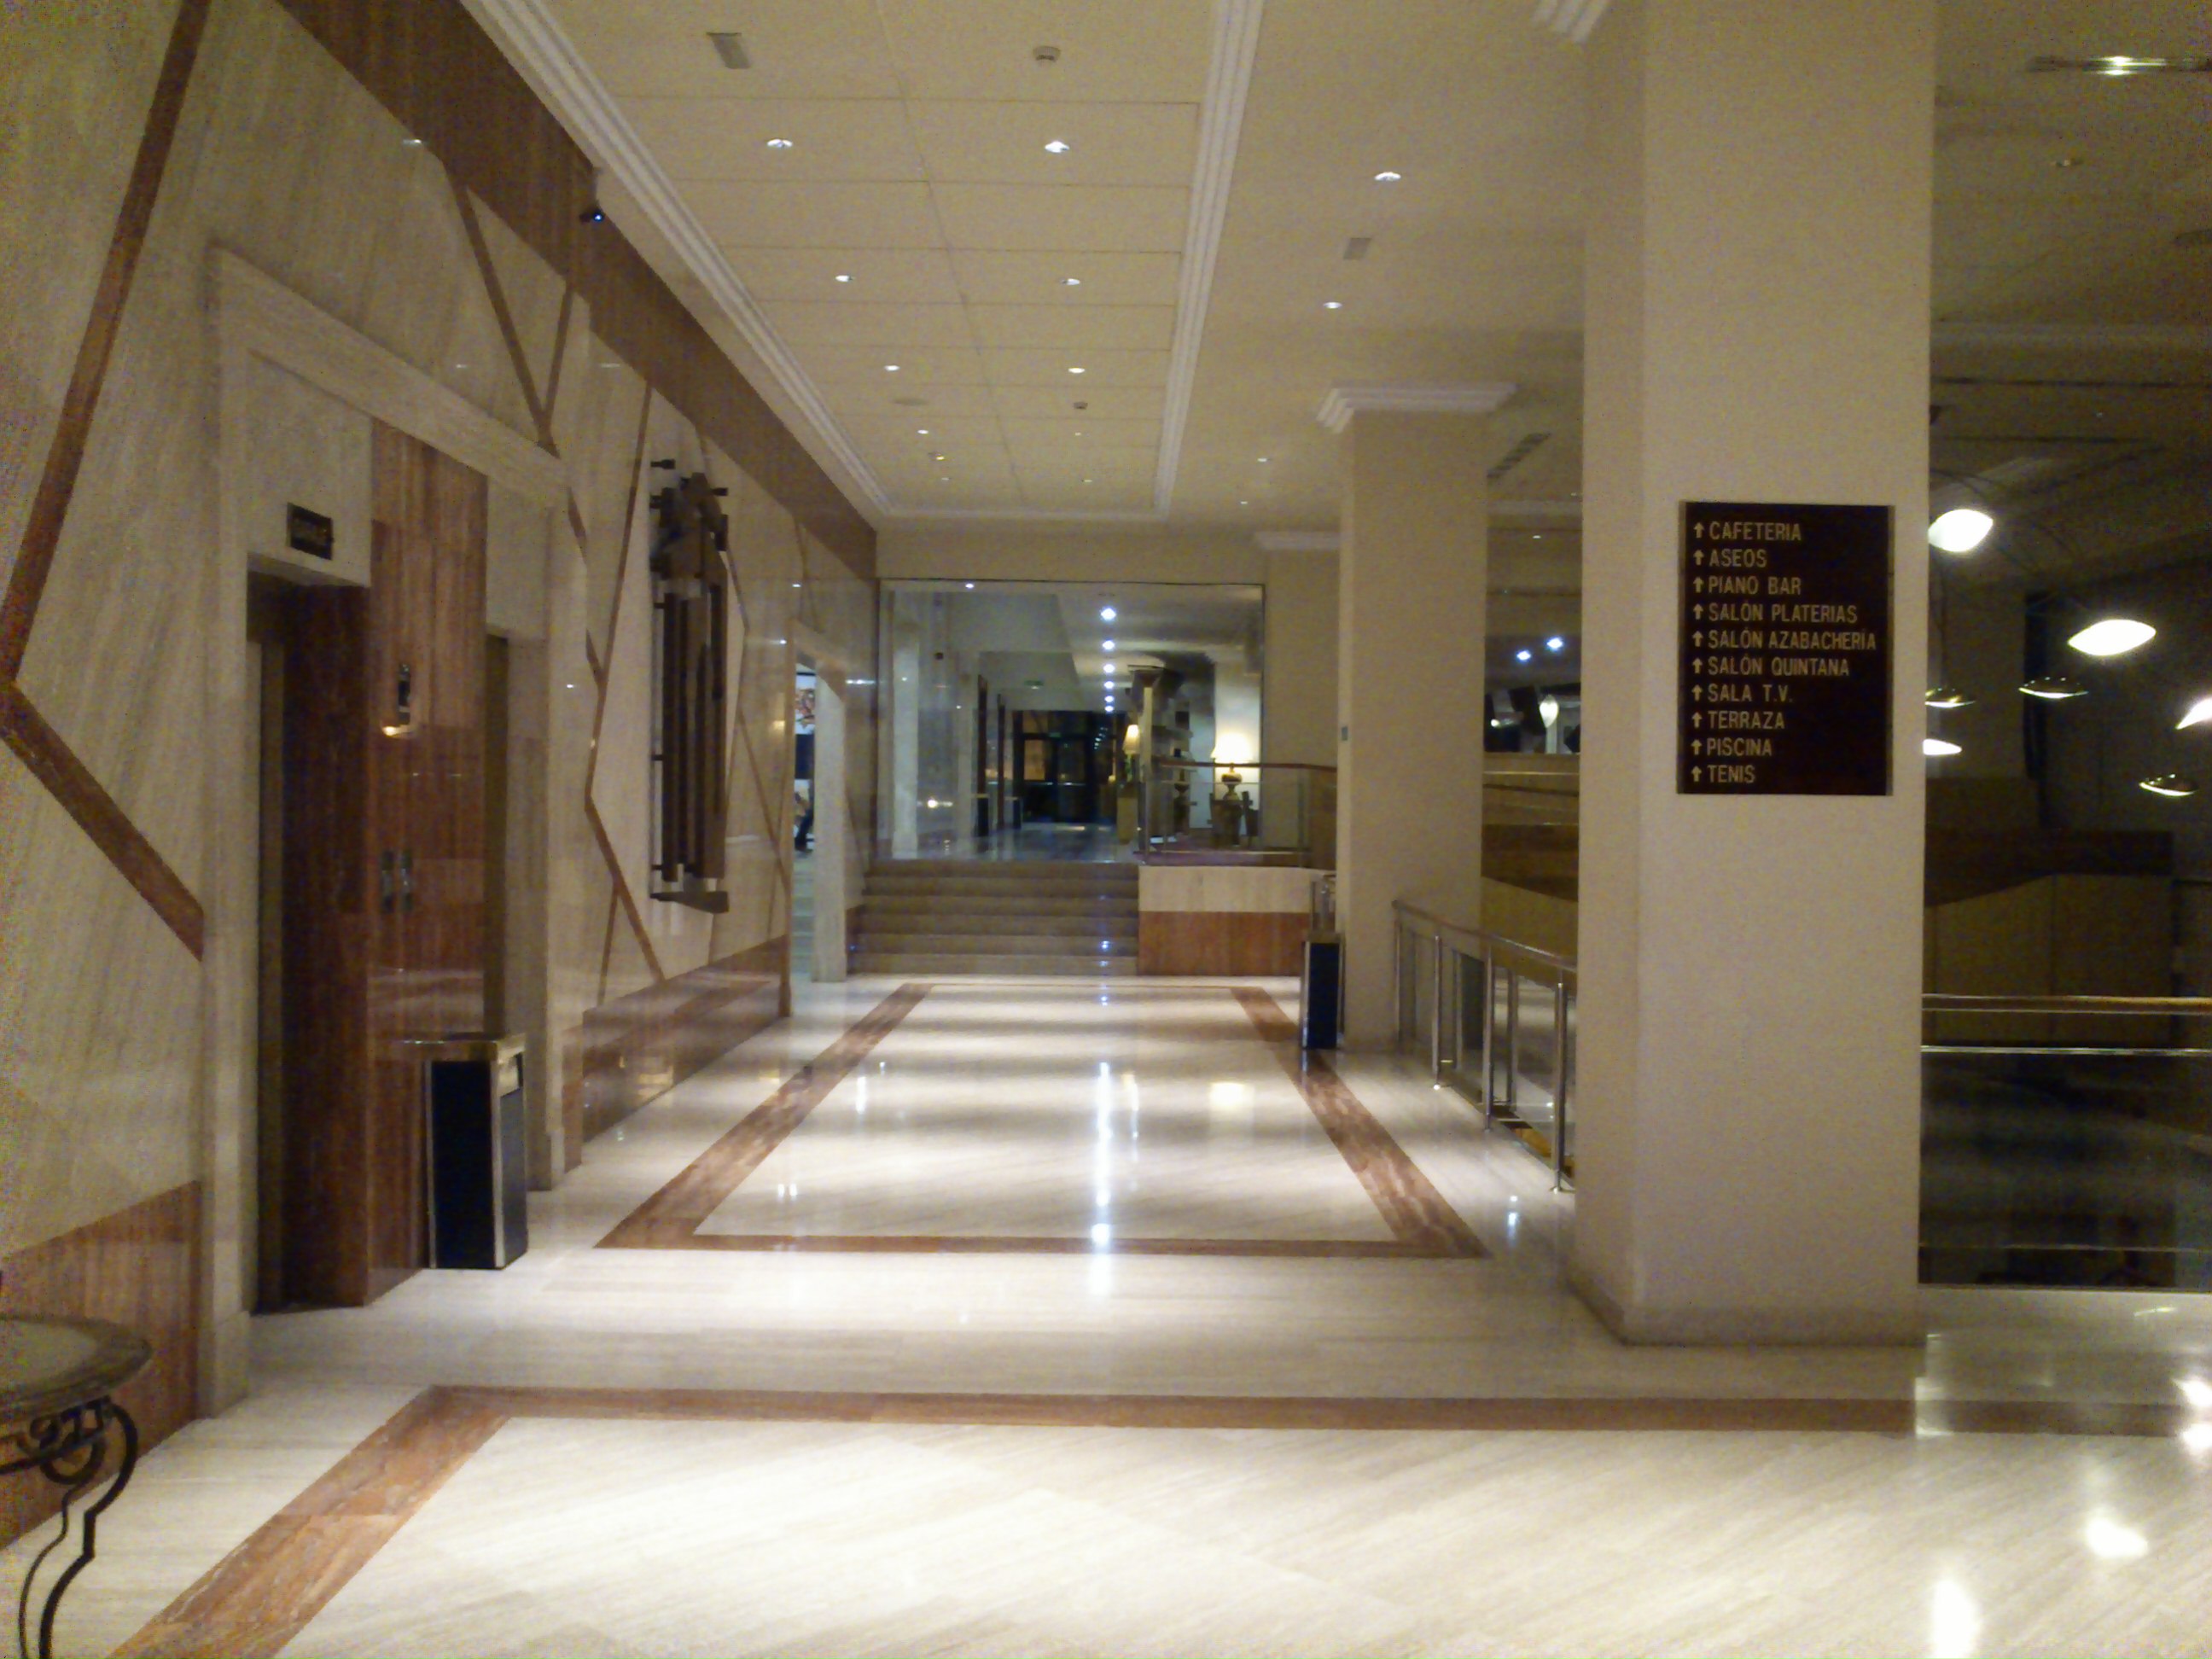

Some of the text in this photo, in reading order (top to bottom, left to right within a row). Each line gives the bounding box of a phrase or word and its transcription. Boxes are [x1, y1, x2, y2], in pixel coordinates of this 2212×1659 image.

[1708, 521, 1802, 541] CAFETERIA
[1708, 548, 1767, 568] ASEOS
[1708, 575, 1802, 596] PIANO BAR
[1771, 656, 1850, 677] QUINTANA
[1708, 683, 1753, 702] SALA
[1708, 710, 1785, 730] TERRAZA
[1707, 736, 1773, 757] PISCINA
[1707, 764, 1755, 783] TENIS
